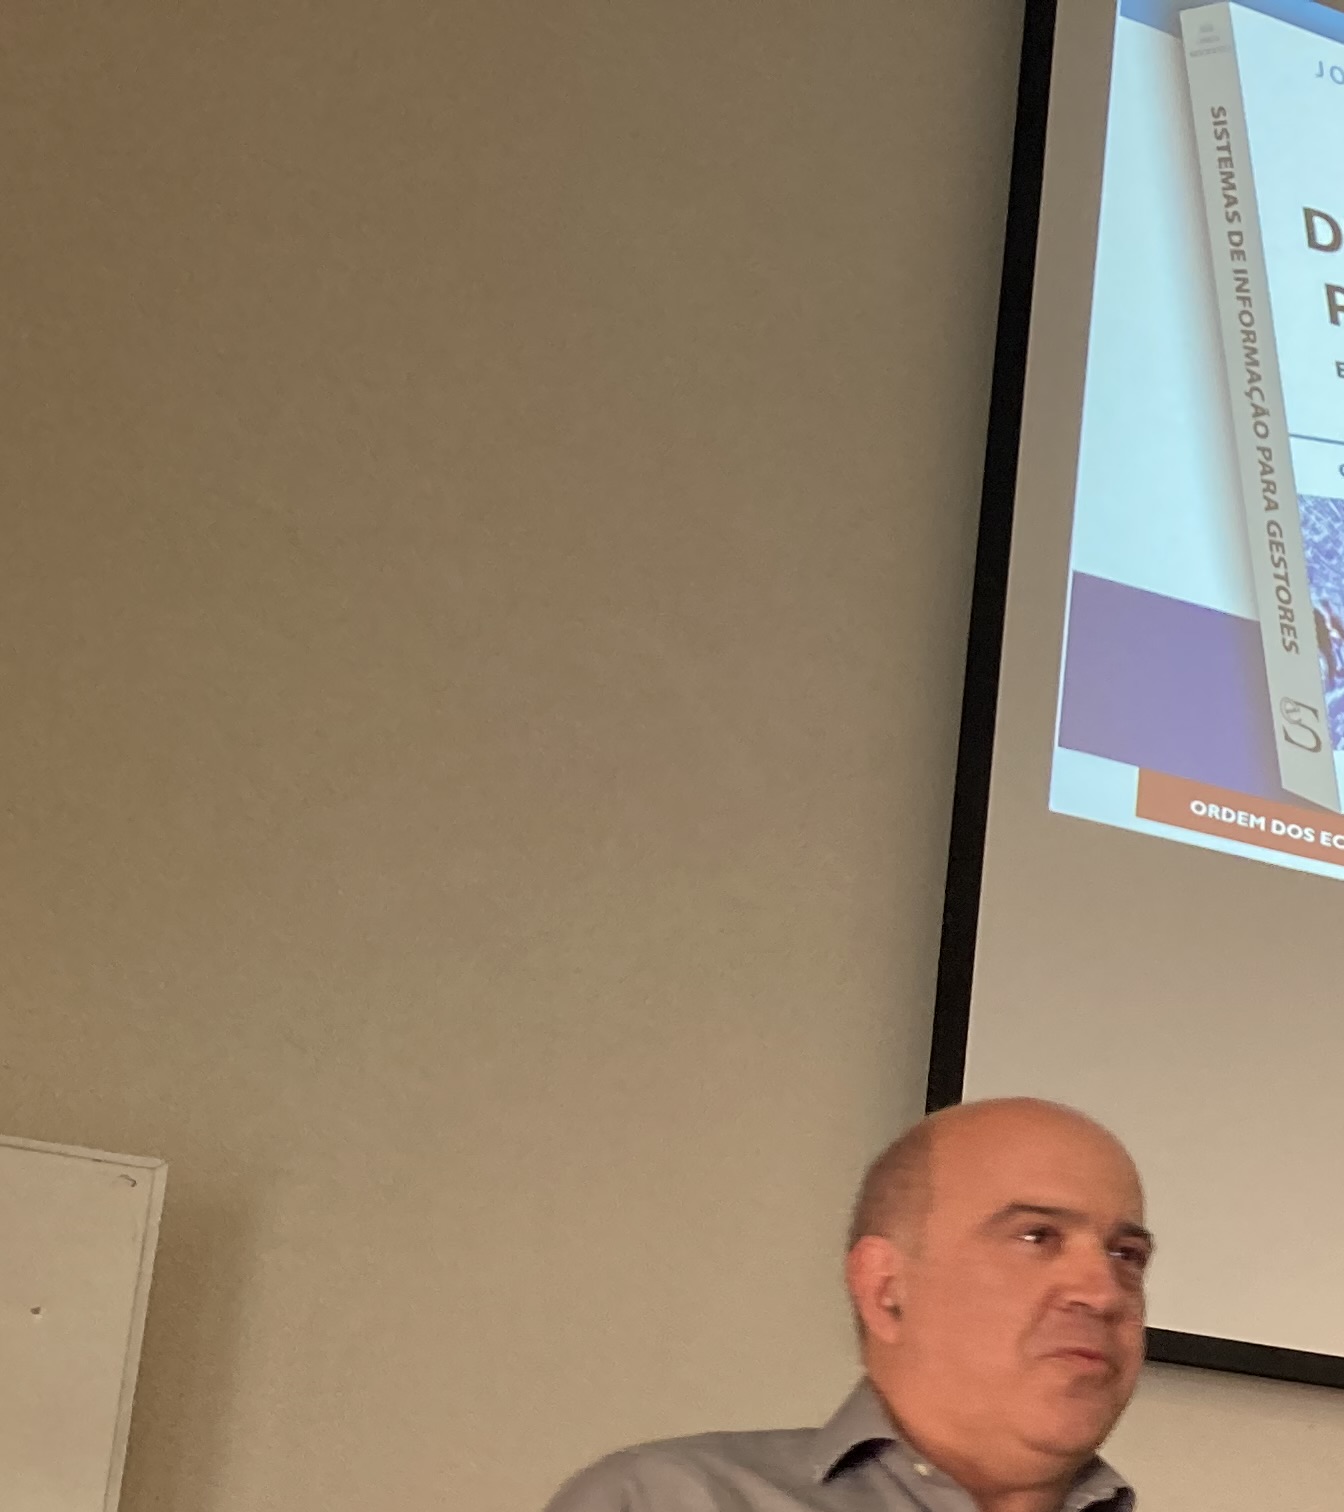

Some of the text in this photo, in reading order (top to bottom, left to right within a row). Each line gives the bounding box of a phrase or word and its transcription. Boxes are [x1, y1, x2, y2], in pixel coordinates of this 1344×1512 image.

[1211, 106, 1300, 655] SISTEMAS DE INFORMAÇÃO PARA GESTORES
[1190, 799, 1266, 832] ORDEM
[1271, 817, 1316, 844] DOS
